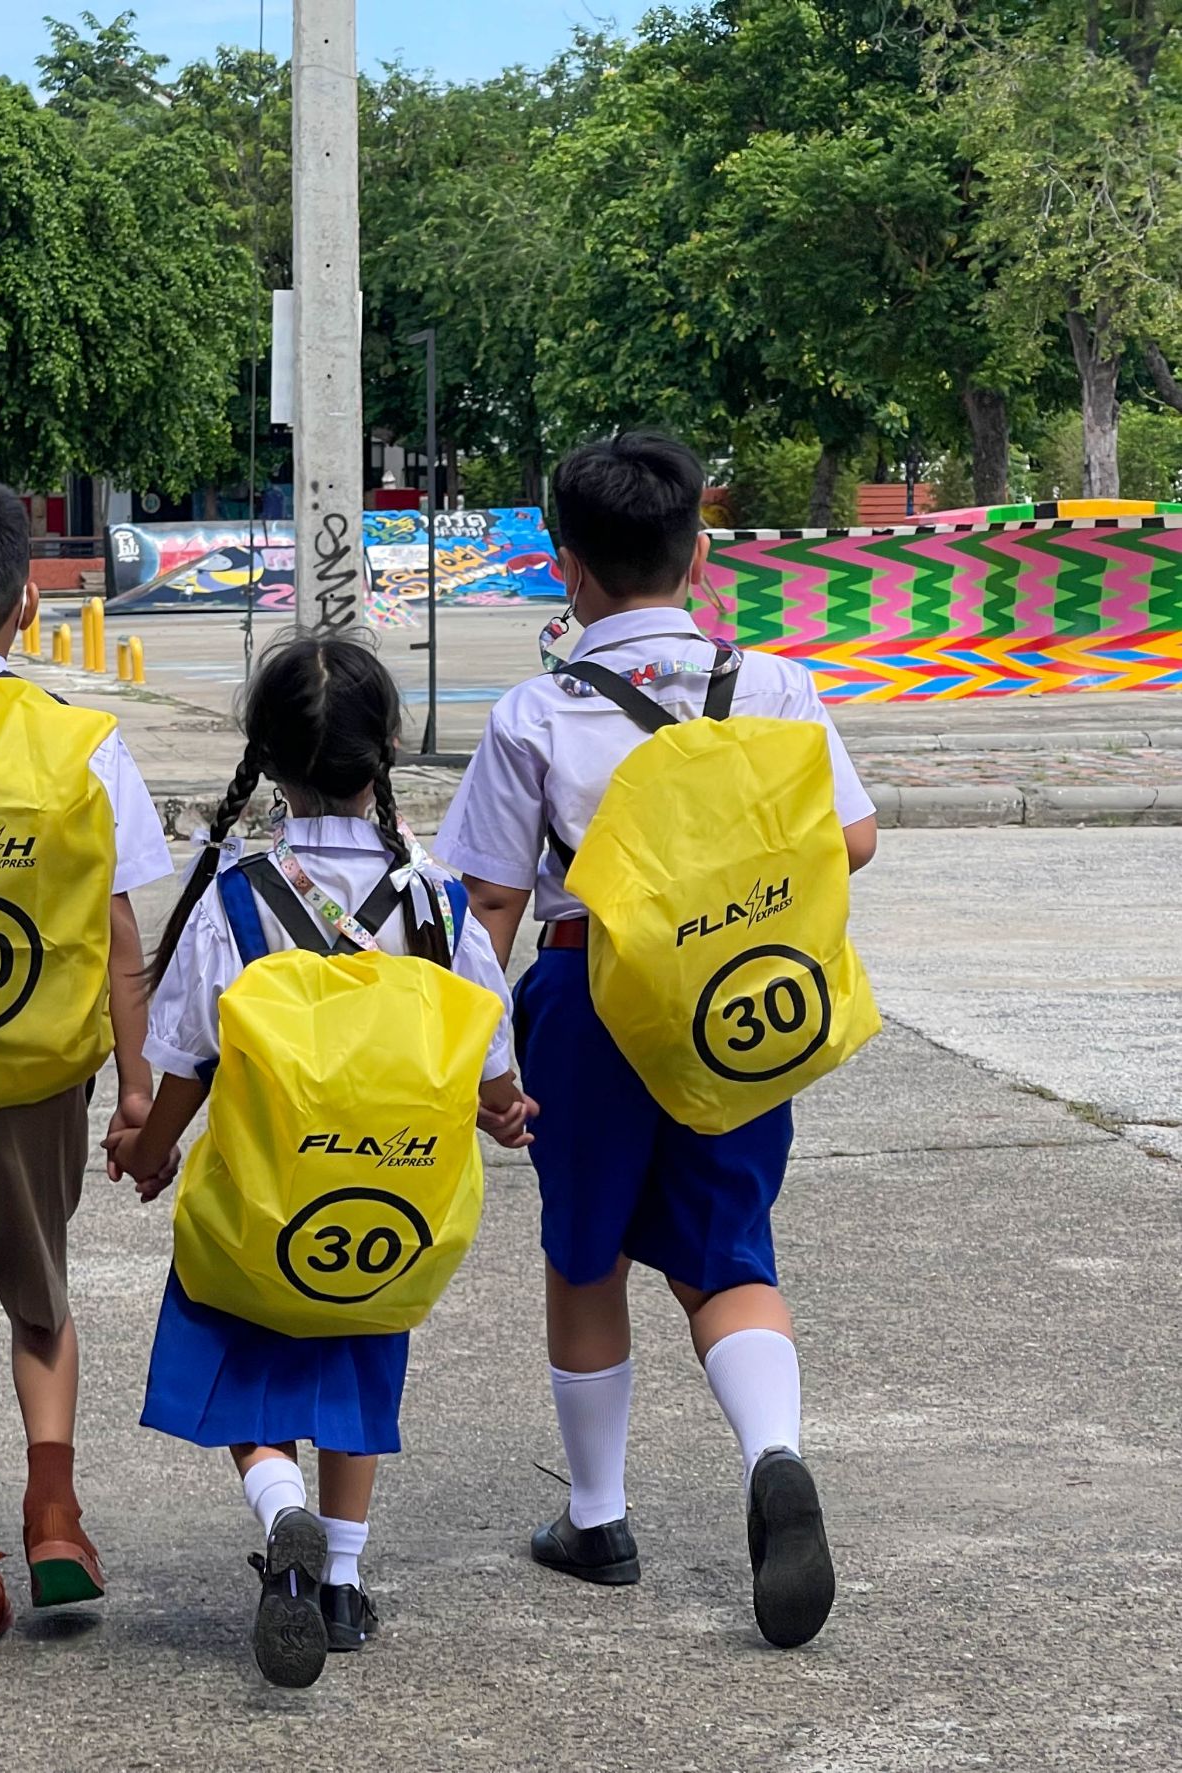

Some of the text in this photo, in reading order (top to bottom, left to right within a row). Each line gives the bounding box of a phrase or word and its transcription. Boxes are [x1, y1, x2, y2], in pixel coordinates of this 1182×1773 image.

[756, 896, 793, 922] EXPRESS
[722, 976, 807, 1051] 30
[387, 1157, 436, 1167] EXPRESS
[307, 1225, 402, 1274] 30
